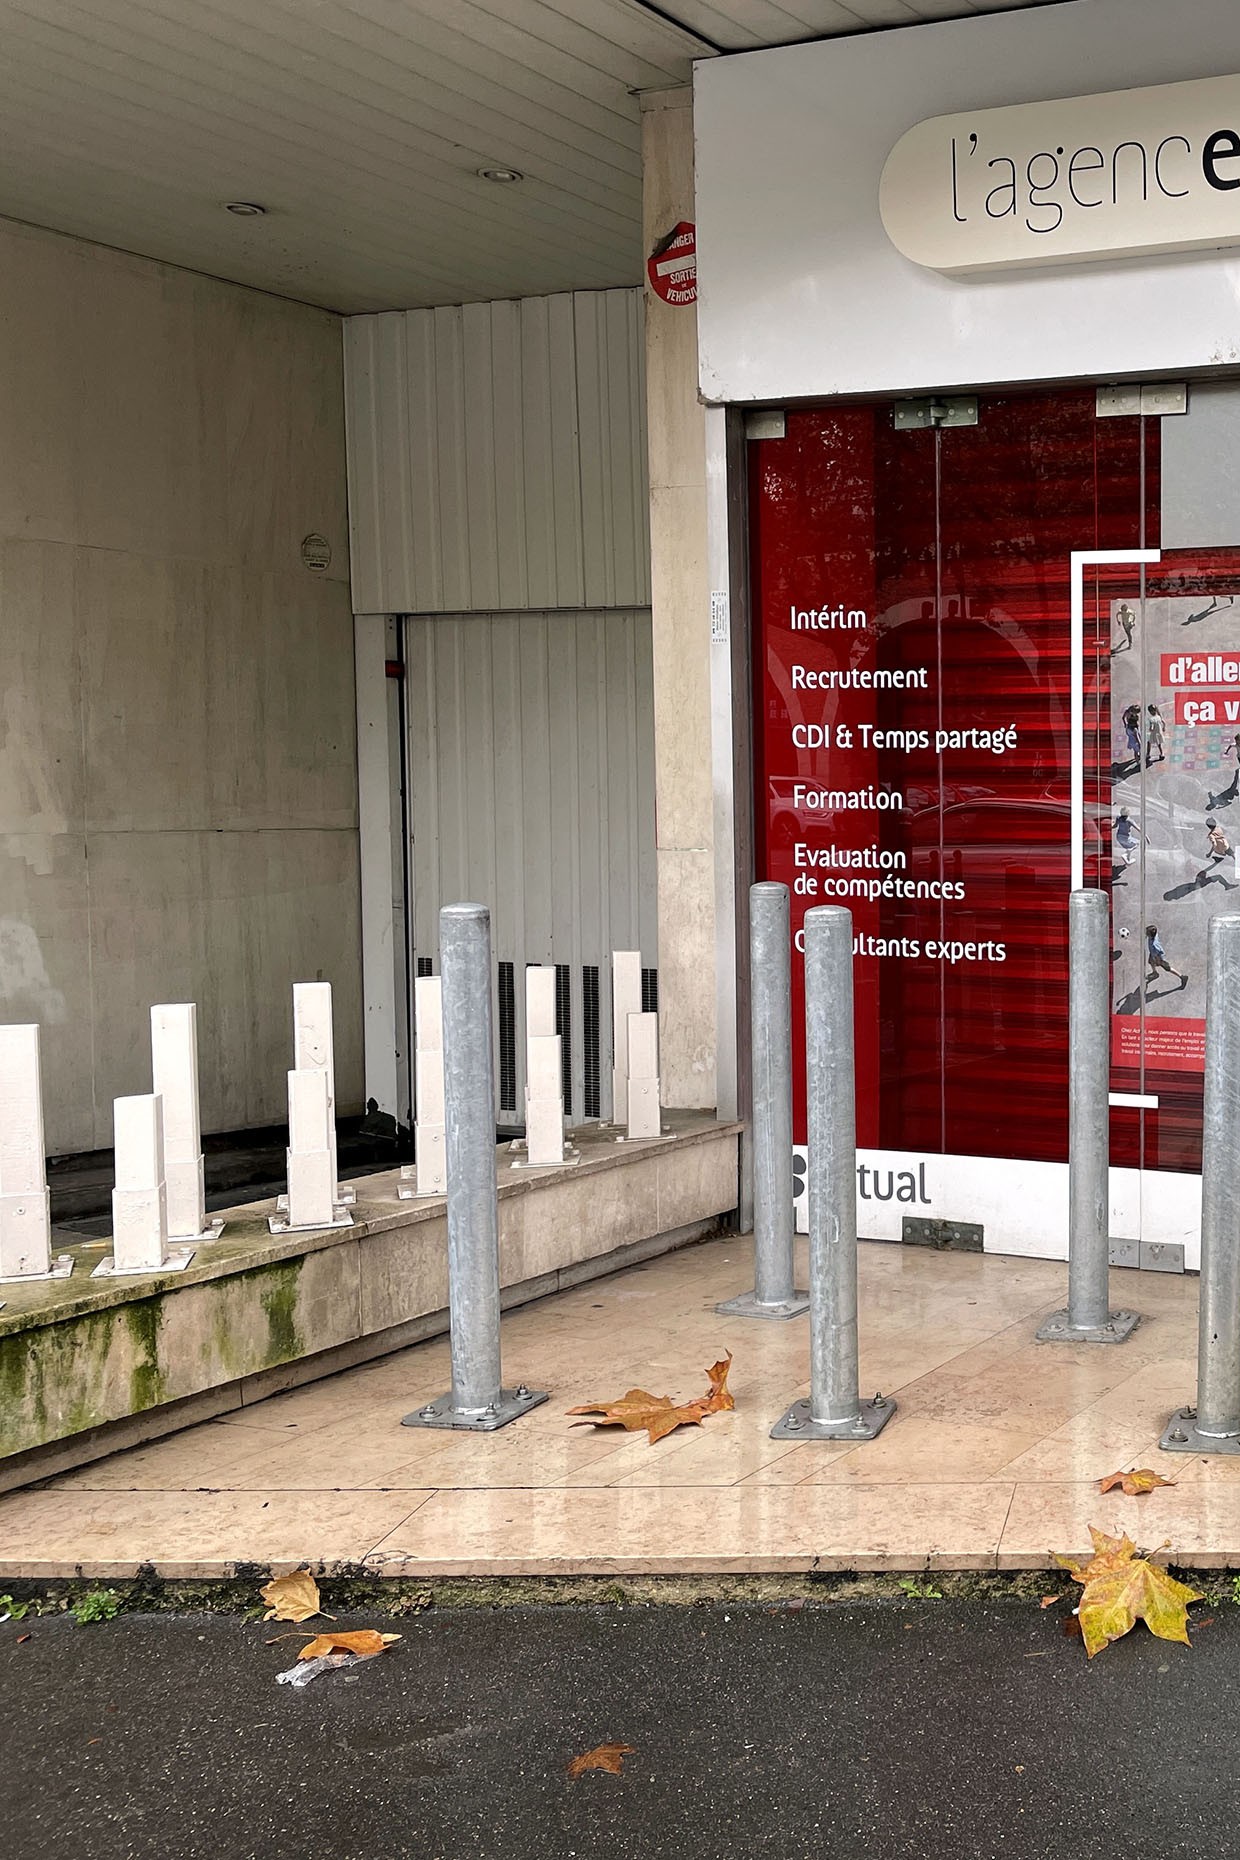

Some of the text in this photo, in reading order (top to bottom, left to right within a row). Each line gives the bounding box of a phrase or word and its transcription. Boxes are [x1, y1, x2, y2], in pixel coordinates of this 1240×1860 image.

[666, 286, 697, 302] VEHICU
[791, 605, 866, 629] Intérim
[792, 666, 928, 689] Recrutement
[1183, 702, 1216, 728] ça
[792, 724, 1017, 754] CDI & Temps partagé
[794, 785, 902, 809] Formation
[795, 843, 905, 868] Evaluation
[794, 872, 965, 902] de compétences
[925, 936, 1007, 963] experts
[855, 1159, 931, 1206] tual
